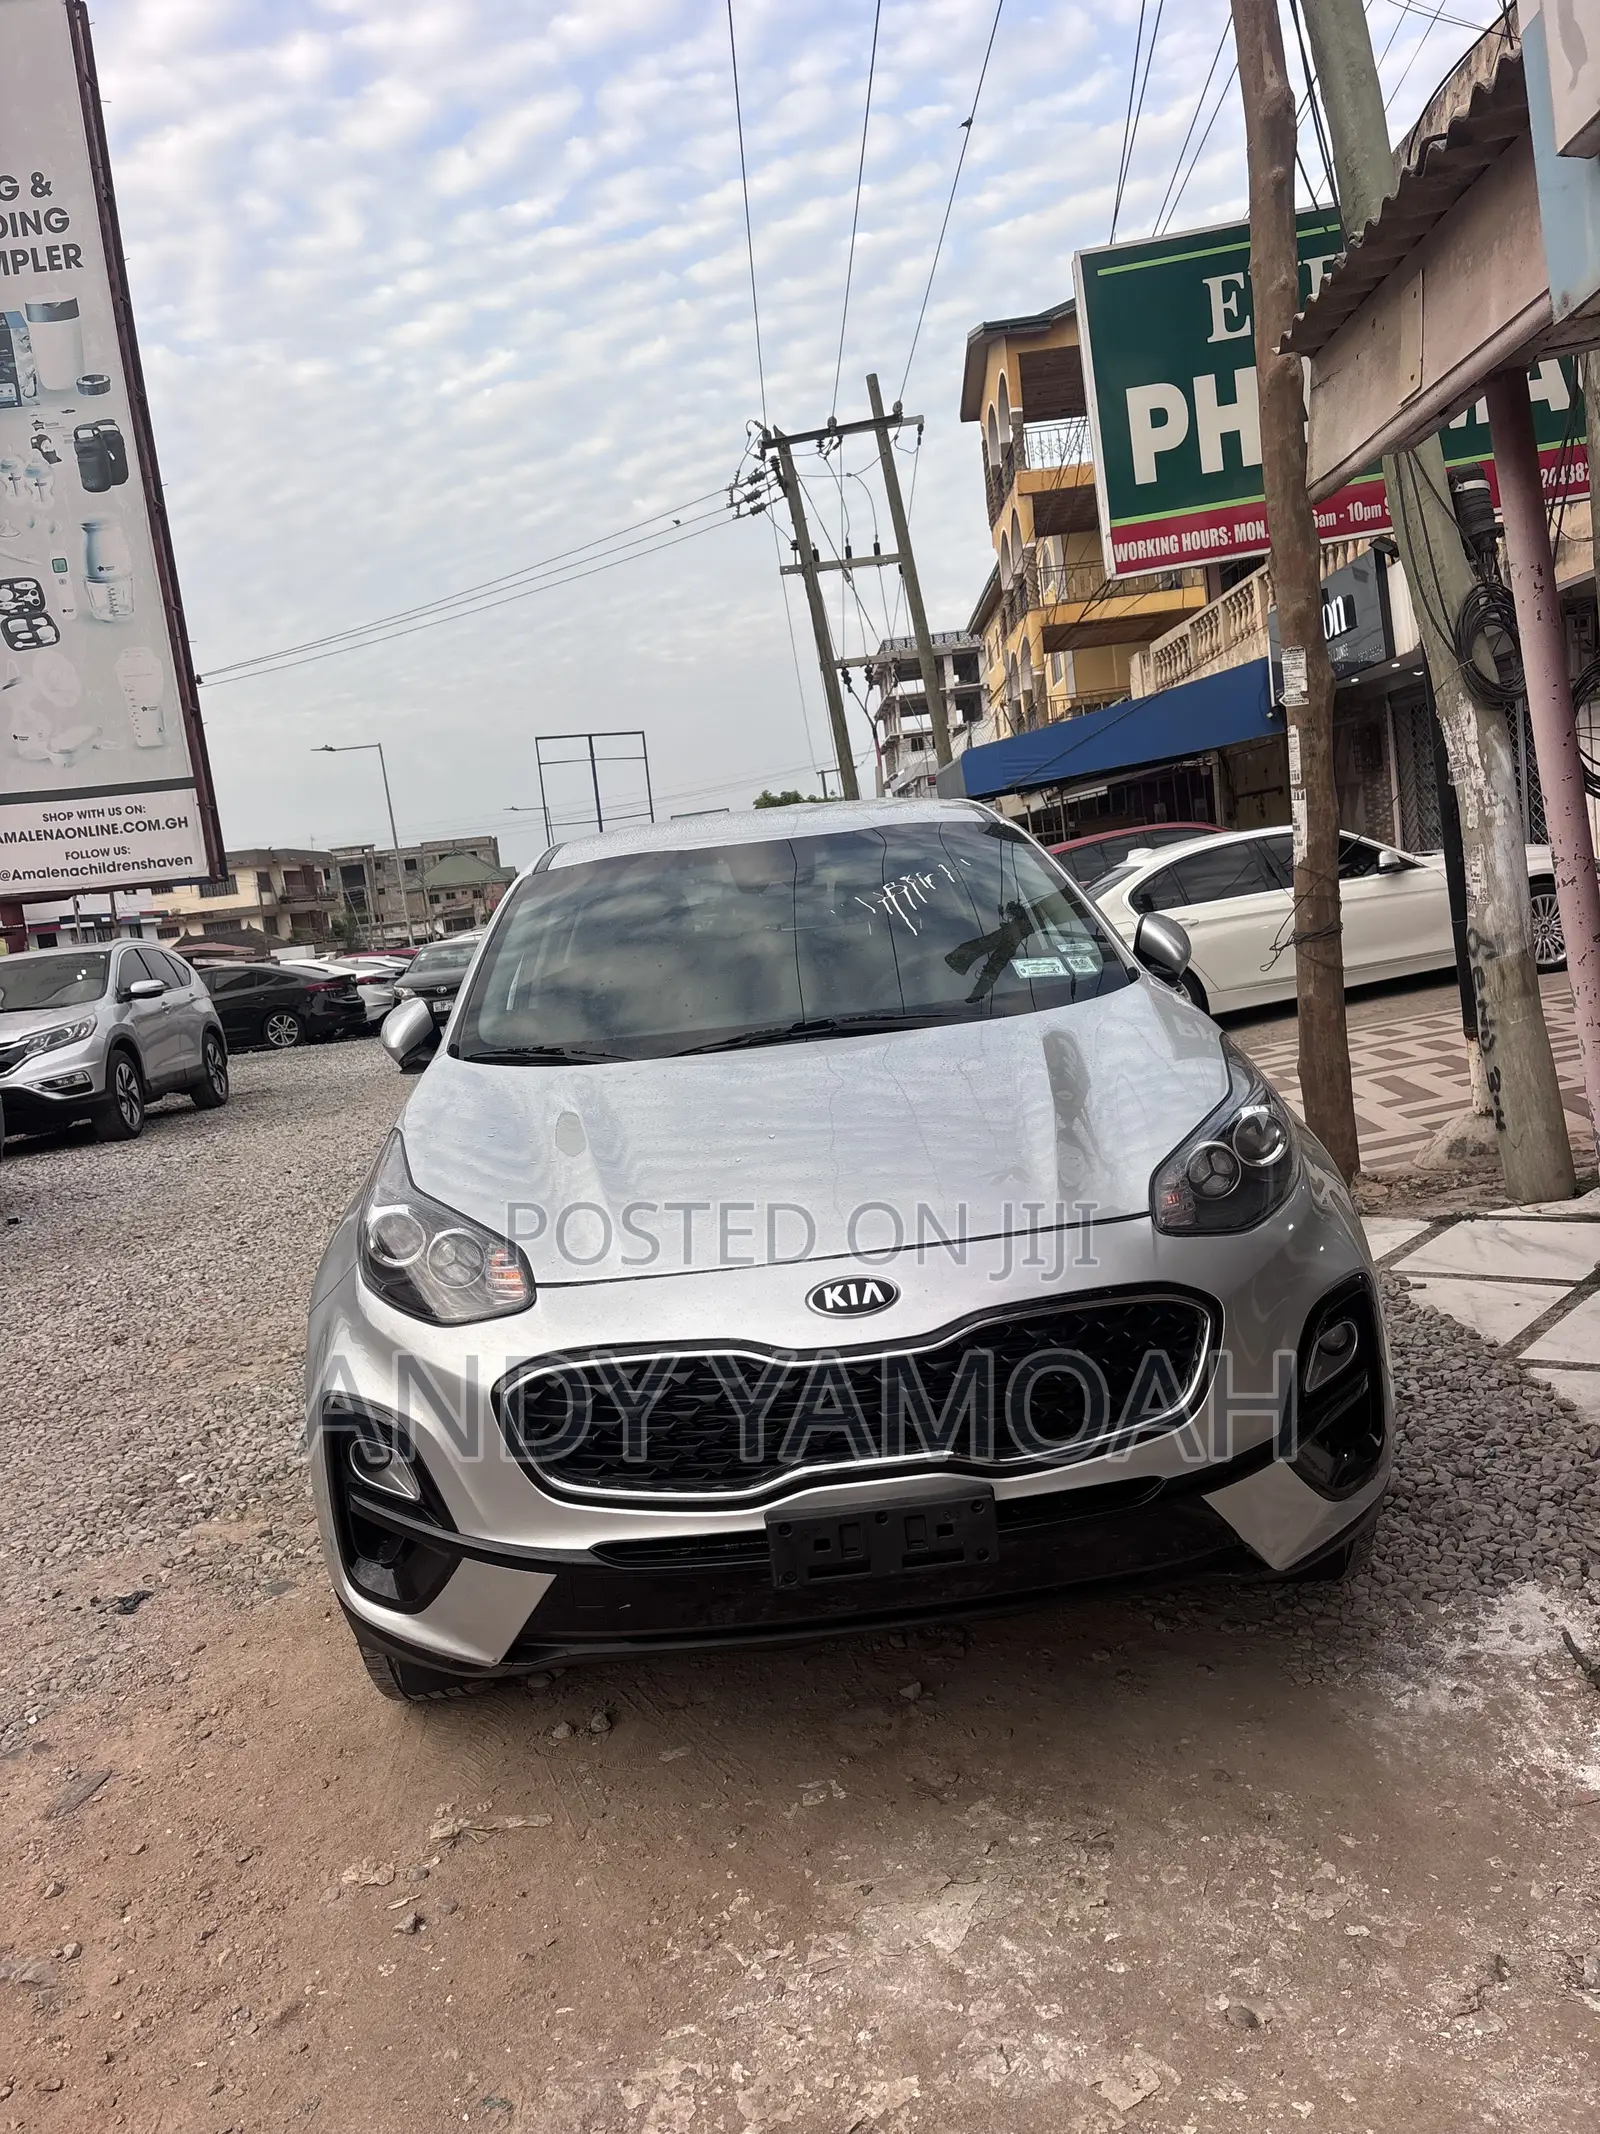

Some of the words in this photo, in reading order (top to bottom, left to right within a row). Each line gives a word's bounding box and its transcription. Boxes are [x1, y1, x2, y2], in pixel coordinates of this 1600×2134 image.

[30, 171, 53, 198] &
[1113, 534, 1179, 563] WORKING
[1181, 526, 1233, 552] HOURS:
[1234, 519, 1270, 544] MON.
[1347, 501, 1382, 522] 10pm
[42, 811, 74, 823] SHOP
[76, 808, 105, 820] WITH
[107, 807, 122, 817] US
[125, 805, 146, 815] ON:
[65, 847, 110, 860] FOLLOW
[113, 845, 131, 856] US:
[0, 855, 193, 882] @Amalenachildrenshaven
[823, 1282, 886, 1309] KIA
